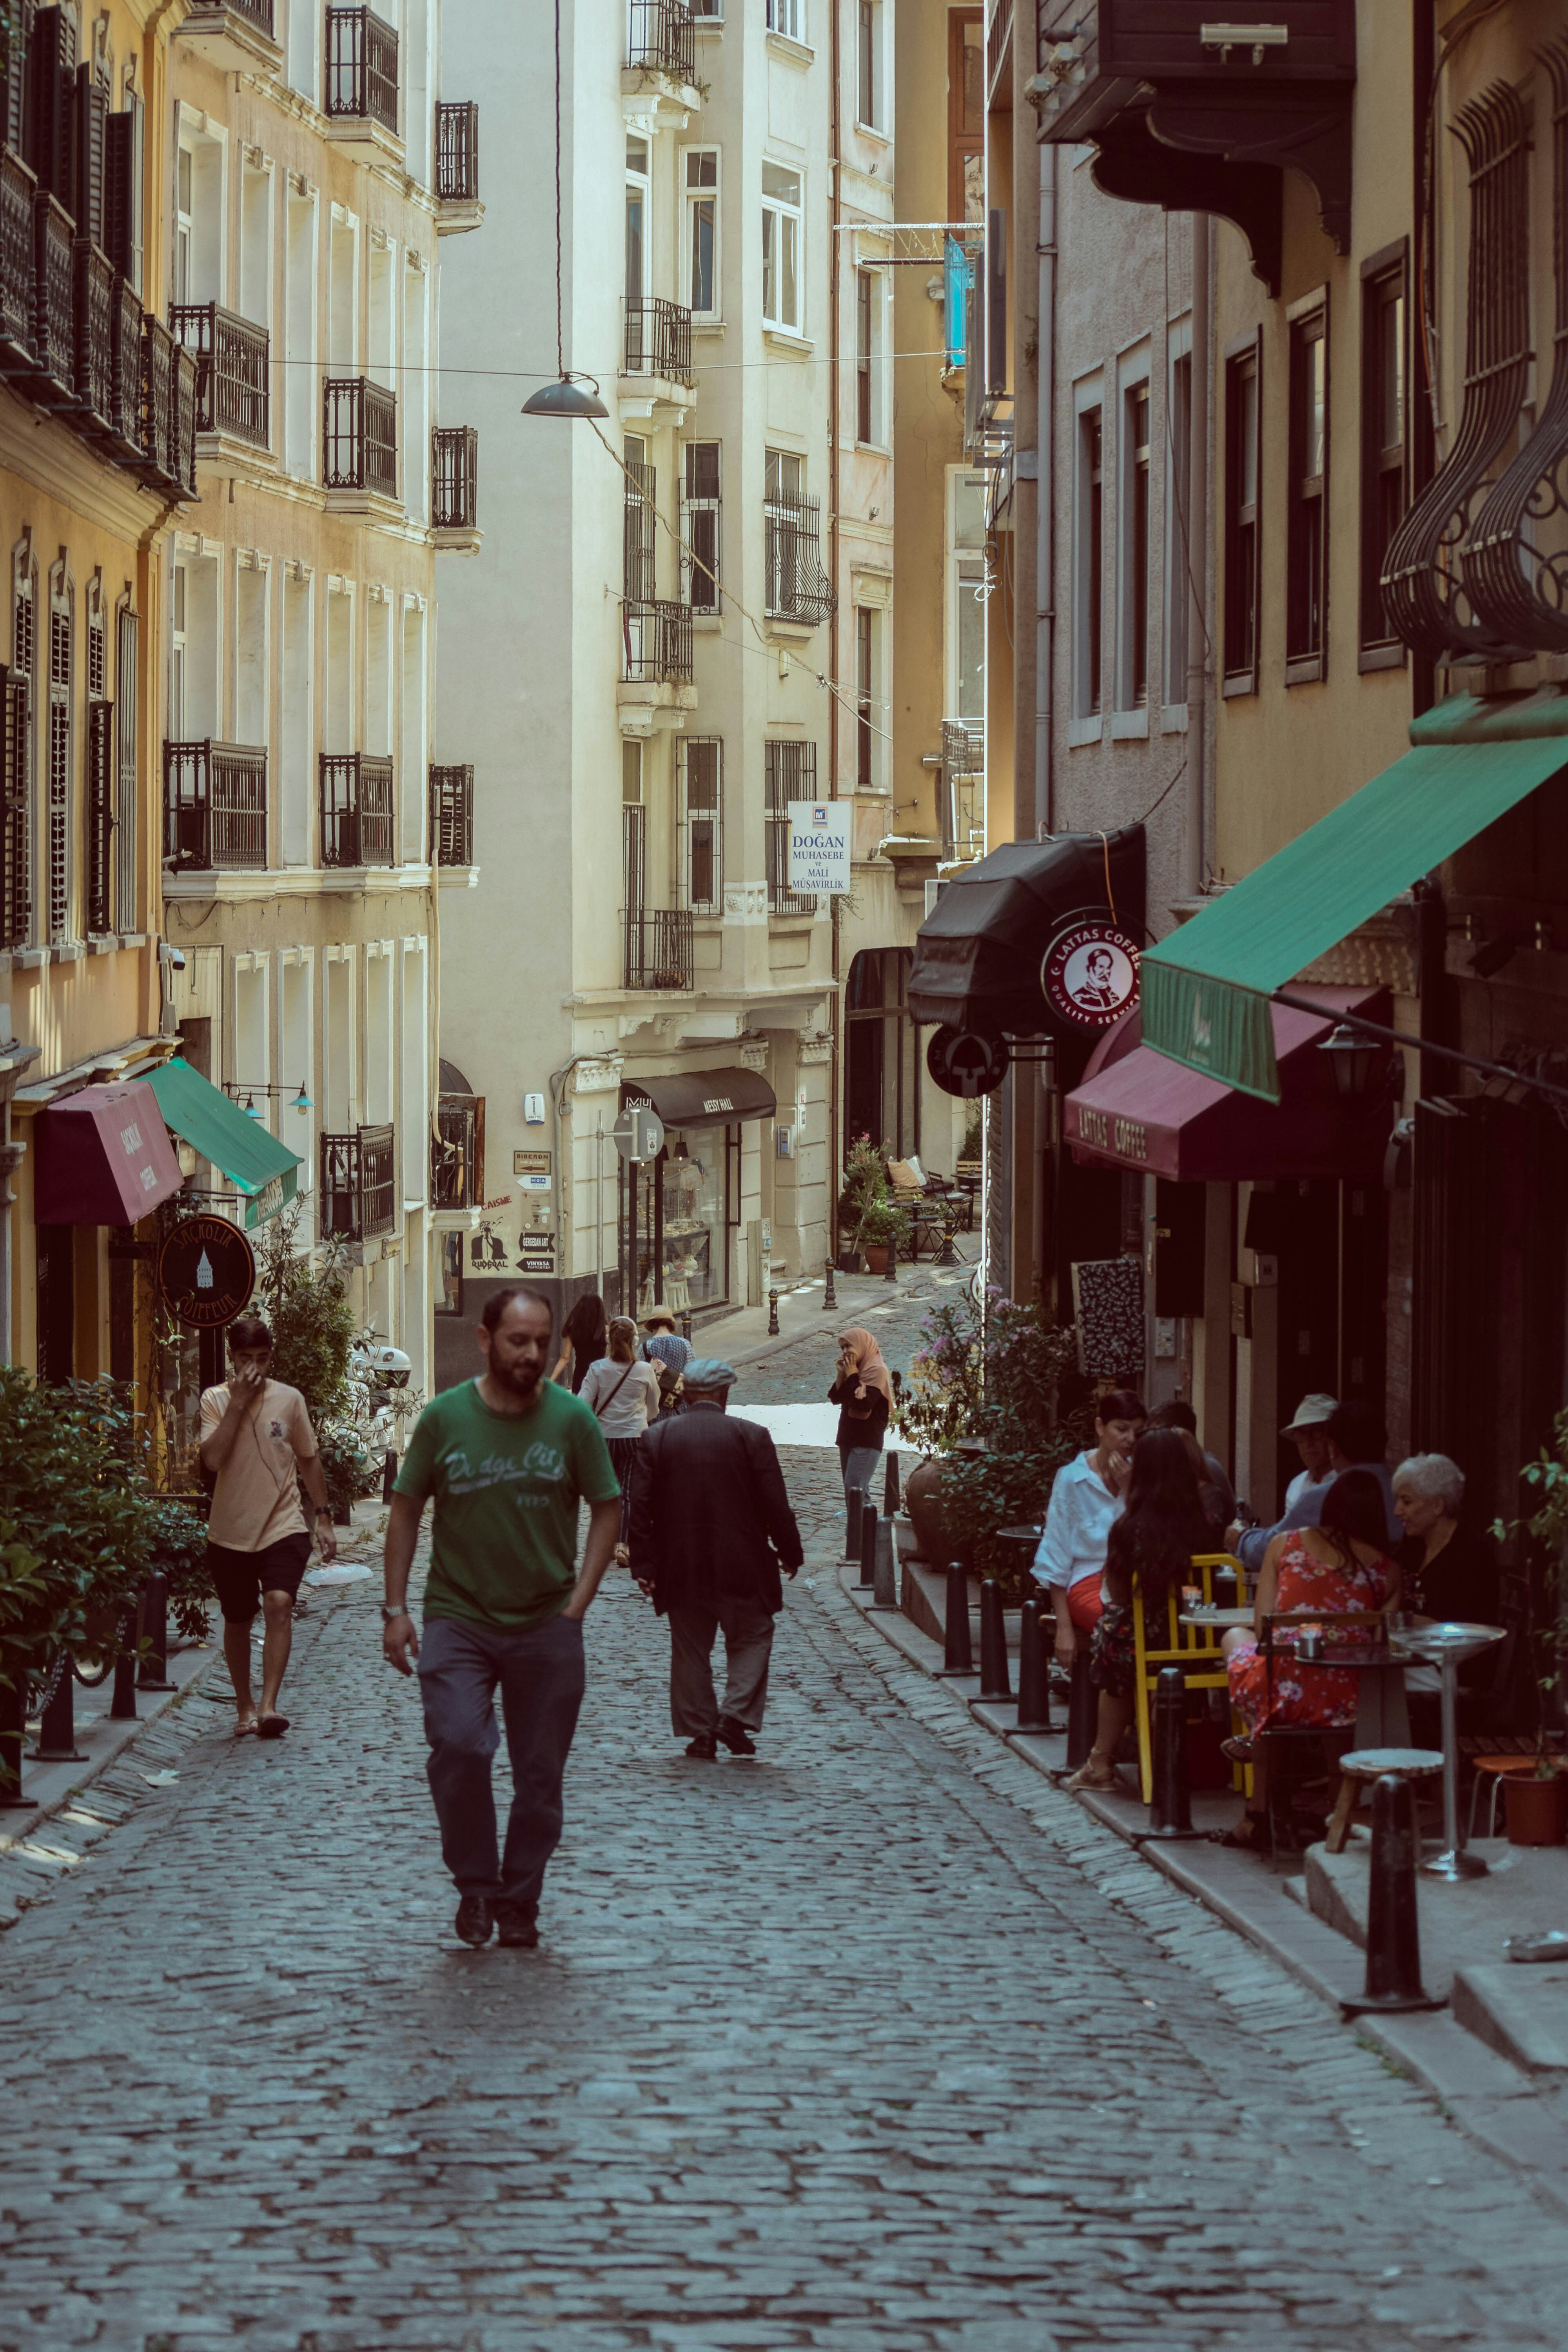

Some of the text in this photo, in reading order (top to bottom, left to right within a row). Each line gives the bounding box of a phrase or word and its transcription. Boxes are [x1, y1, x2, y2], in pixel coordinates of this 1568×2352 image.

[793, 833, 844, 848] DOĞAN
[808, 867, 828, 877] MALİ
[792, 878, 844, 890] MÜŞAVİRLİK
[1056, 928, 1099, 961] LATTAS
[1052, 985, 1091, 1023] QUALITY
[703, 1098, 734, 1113] MESSY HALL
[1079, 1107, 1147, 1160] LATTAS COFFEE
[523, 1237, 541, 1247] GERGEDAN
[472, 1259, 508, 1271] RUDERAL
[179, 1293, 238, 1319] COIFFEUR
